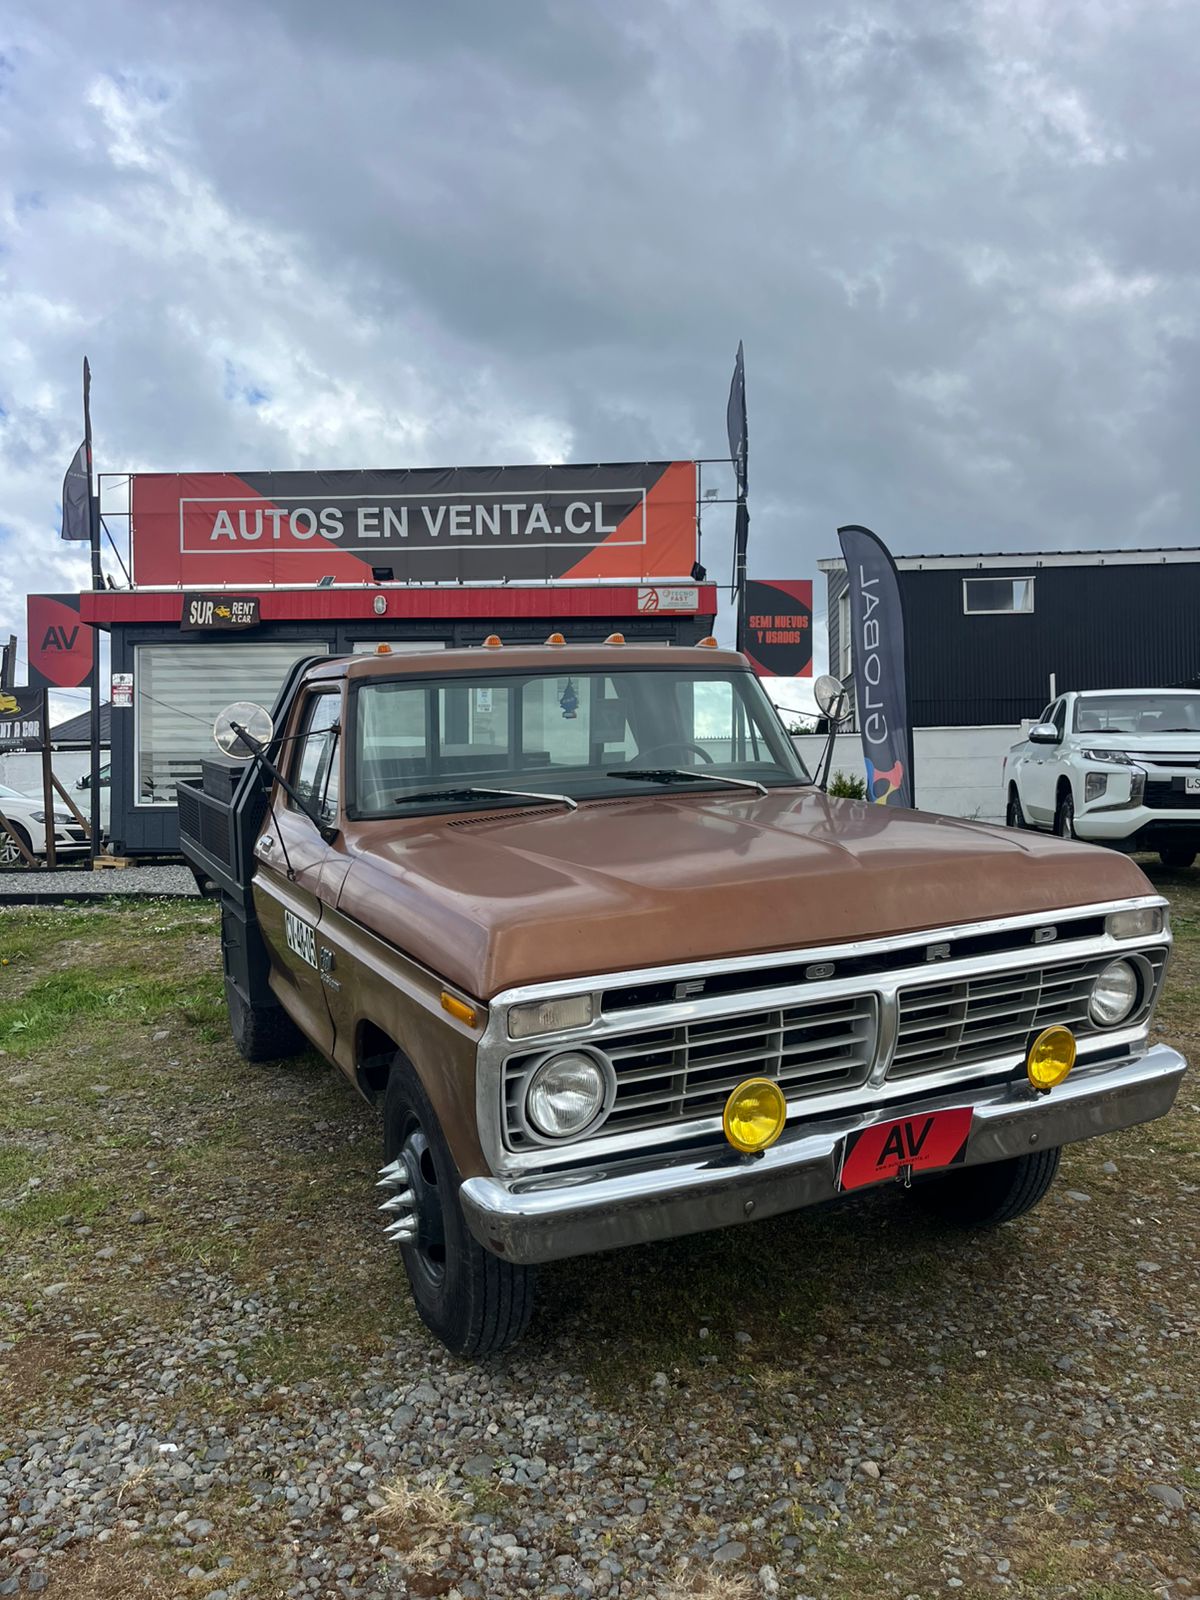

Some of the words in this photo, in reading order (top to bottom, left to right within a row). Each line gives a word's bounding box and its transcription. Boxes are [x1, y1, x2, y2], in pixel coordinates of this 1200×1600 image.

[210, 507, 344, 540] AUTOS
[357, 506, 408, 538] EN
[421, 501, 617, 537] VENTA.CL
[189, 600, 214, 624] SUR
[231, 602, 255, 615] RENT
[231, 615, 237, 623] A
[237, 615, 251, 623] CAR
[749, 615, 772, 628] SEMI
[774, 615, 809, 628] NUEVOS
[41, 626, 80, 650] AV
[757, 631, 763, 643] Y
[765, 631, 800, 643] USADOS
[859, 564, 888, 744] GLOBAL
[13, 721, 20, 738] A
[22, 720, 40, 737] CAR
[674, 925, 1059, 999] FORD
[876, 1117, 935, 1166] AV
